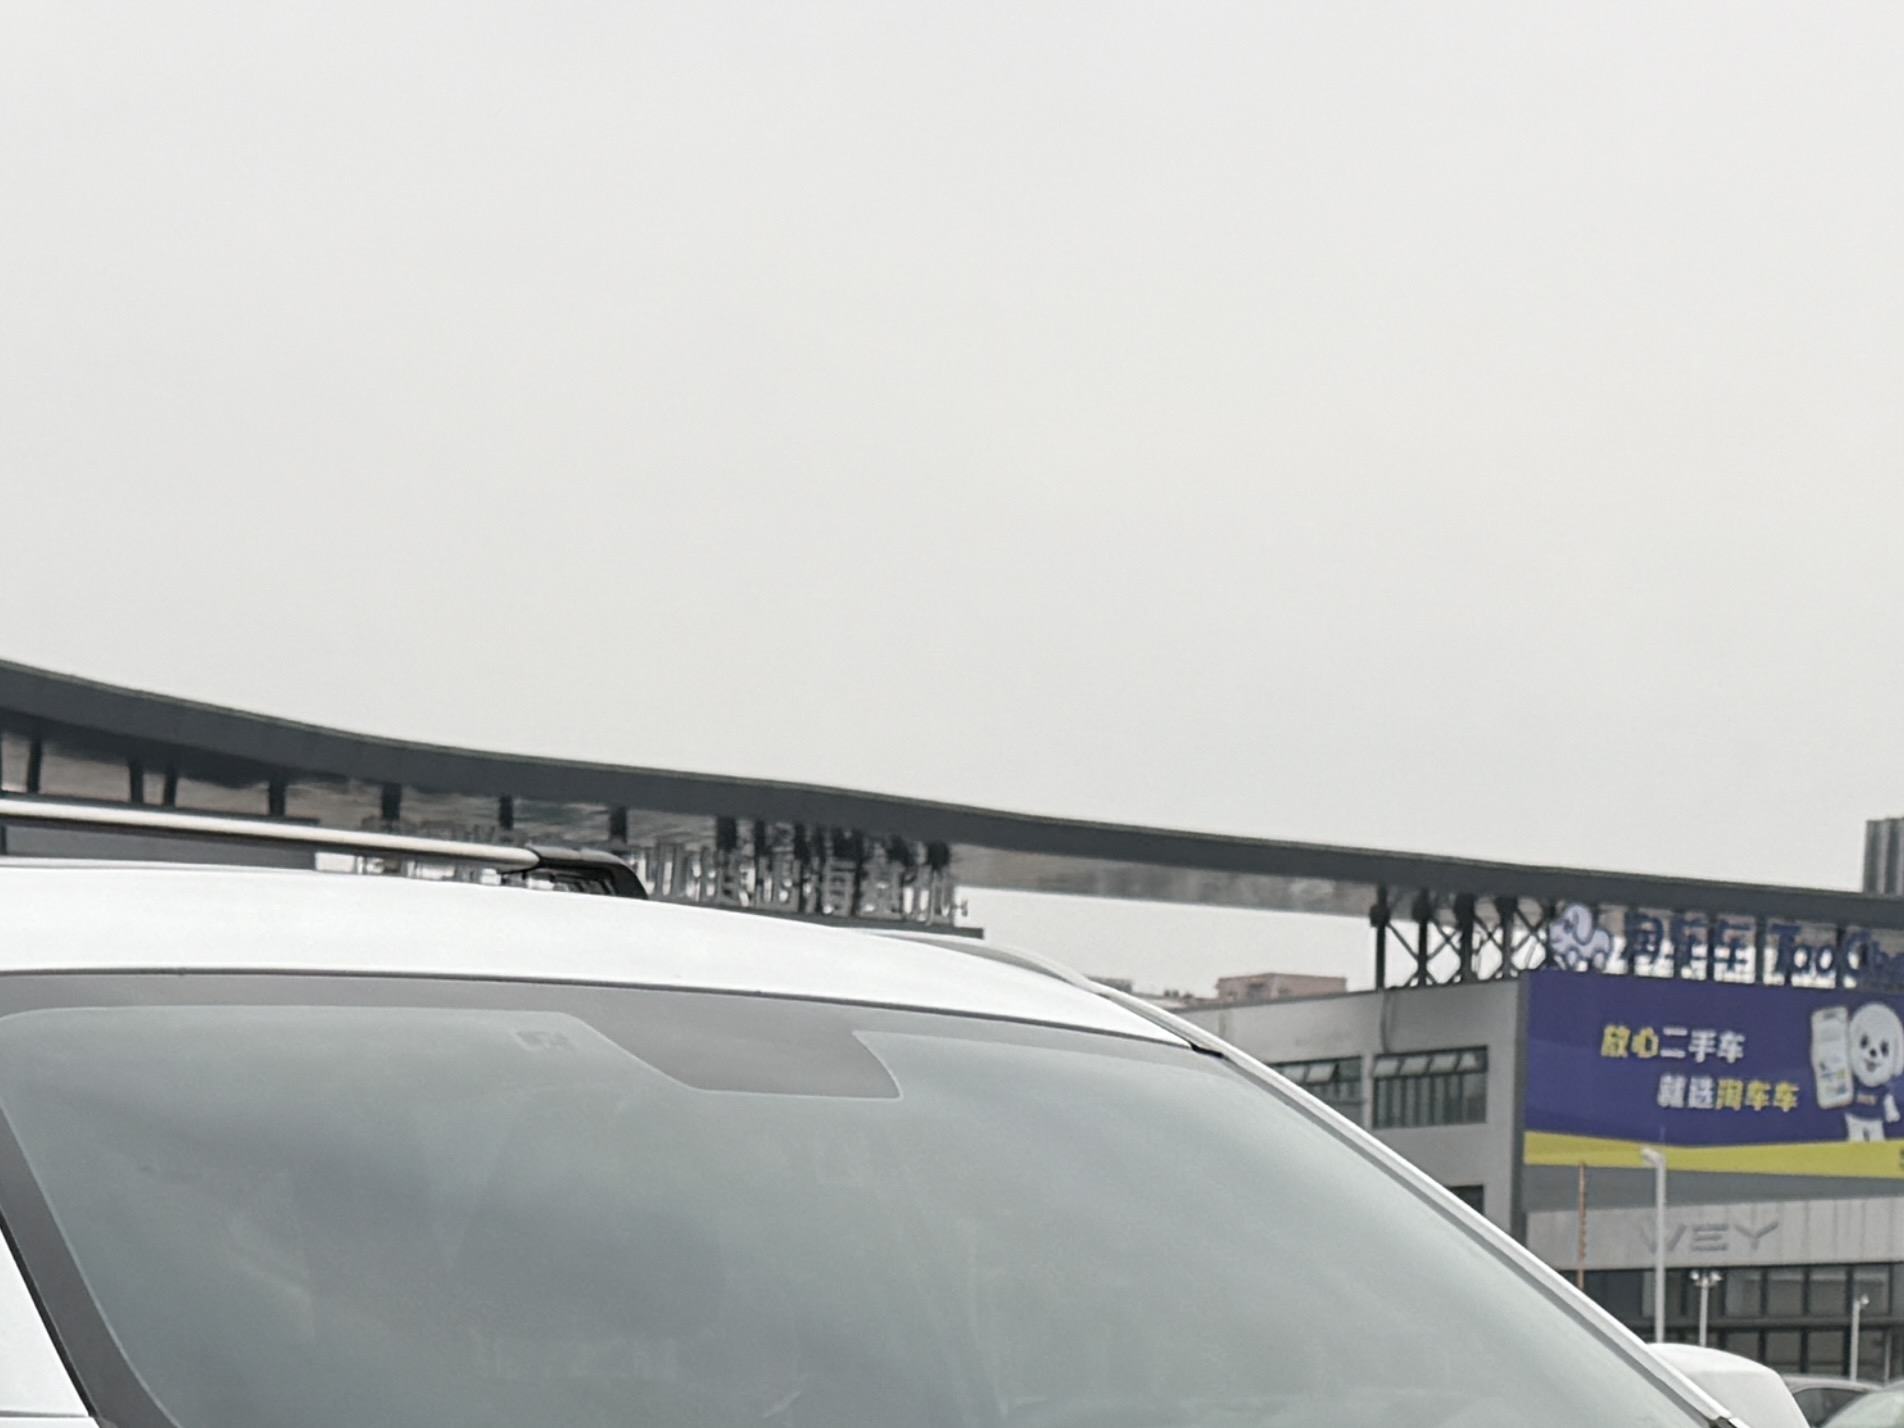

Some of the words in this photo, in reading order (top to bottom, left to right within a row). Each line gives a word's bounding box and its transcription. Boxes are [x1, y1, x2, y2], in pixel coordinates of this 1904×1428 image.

[1601, 1024, 1746, 1064] 放心二手车
[1657, 1074, 1798, 1112] 就选淘车车
[1638, 1221, 1778, 1253] WEY
